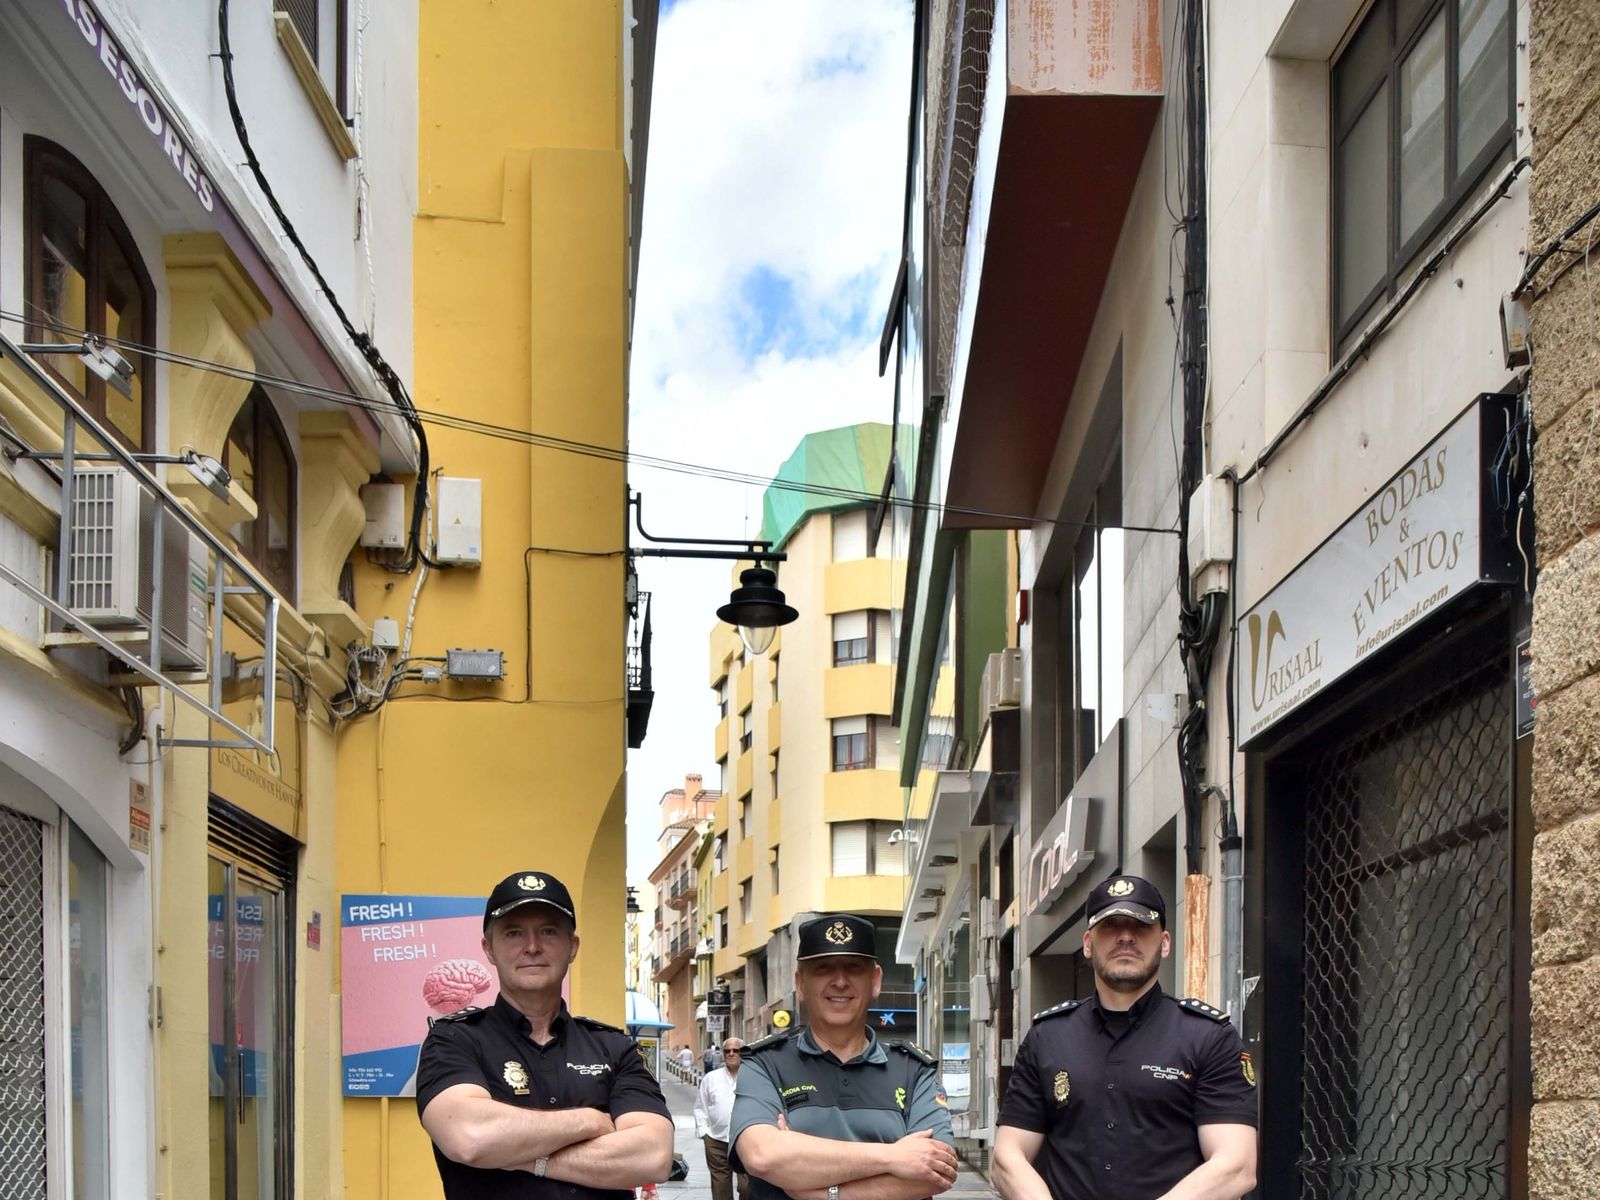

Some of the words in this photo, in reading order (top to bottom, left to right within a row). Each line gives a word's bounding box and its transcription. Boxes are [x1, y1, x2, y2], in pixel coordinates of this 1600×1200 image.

[1365, 446, 1447, 547] BODAS
[1399, 517, 1410, 544] &
[1352, 529, 1465, 640] EVENTOS
[1250, 678, 1321, 735] www.urisaal.com
[349, 902, 404, 922] FRESH
[361, 924, 415, 942] FRESH
[373, 944, 427, 963] FRESH
[1141, 1065, 1186, 1077] POLICIA
[1153, 1072, 1179, 1080] CNP
